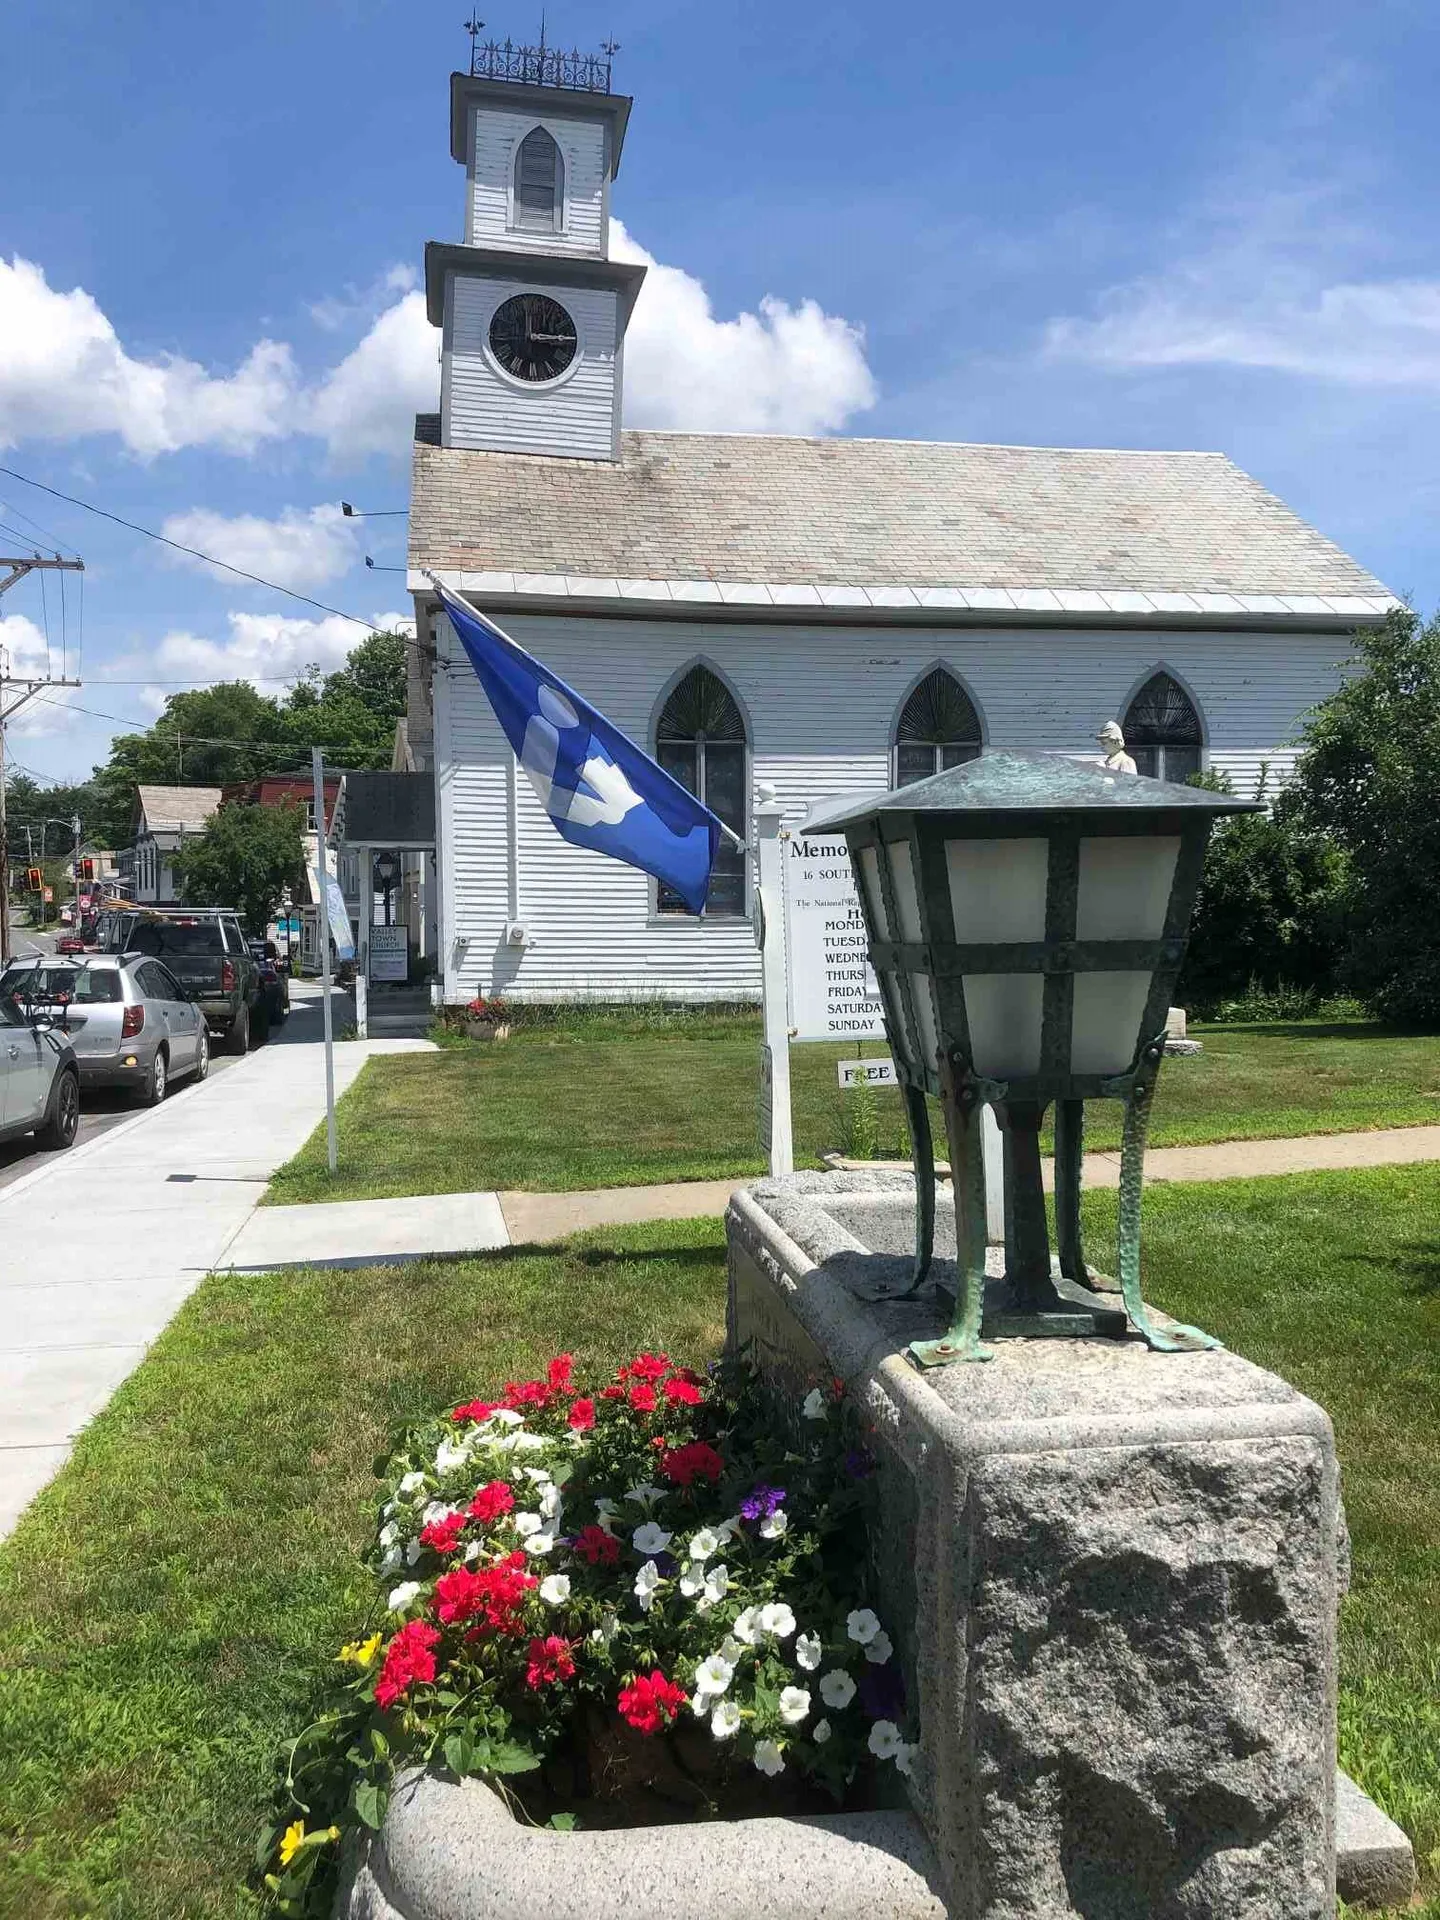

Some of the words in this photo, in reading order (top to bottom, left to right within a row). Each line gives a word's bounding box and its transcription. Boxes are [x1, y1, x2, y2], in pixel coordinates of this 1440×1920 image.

[790, 840, 848, 858] Memo
[803, 870, 814, 880] 16
[796, 899, 810, 907] The
[814, 899, 844, 907] National
[825, 920, 864, 931] MOND
[823, 936, 866, 947] TUESD
[825, 952, 867, 964] WEDNE
[825, 969, 865, 981] THURS
[828, 1019, 875, 1031] SUNDAY
[844, 1066, 890, 1083] FEE
